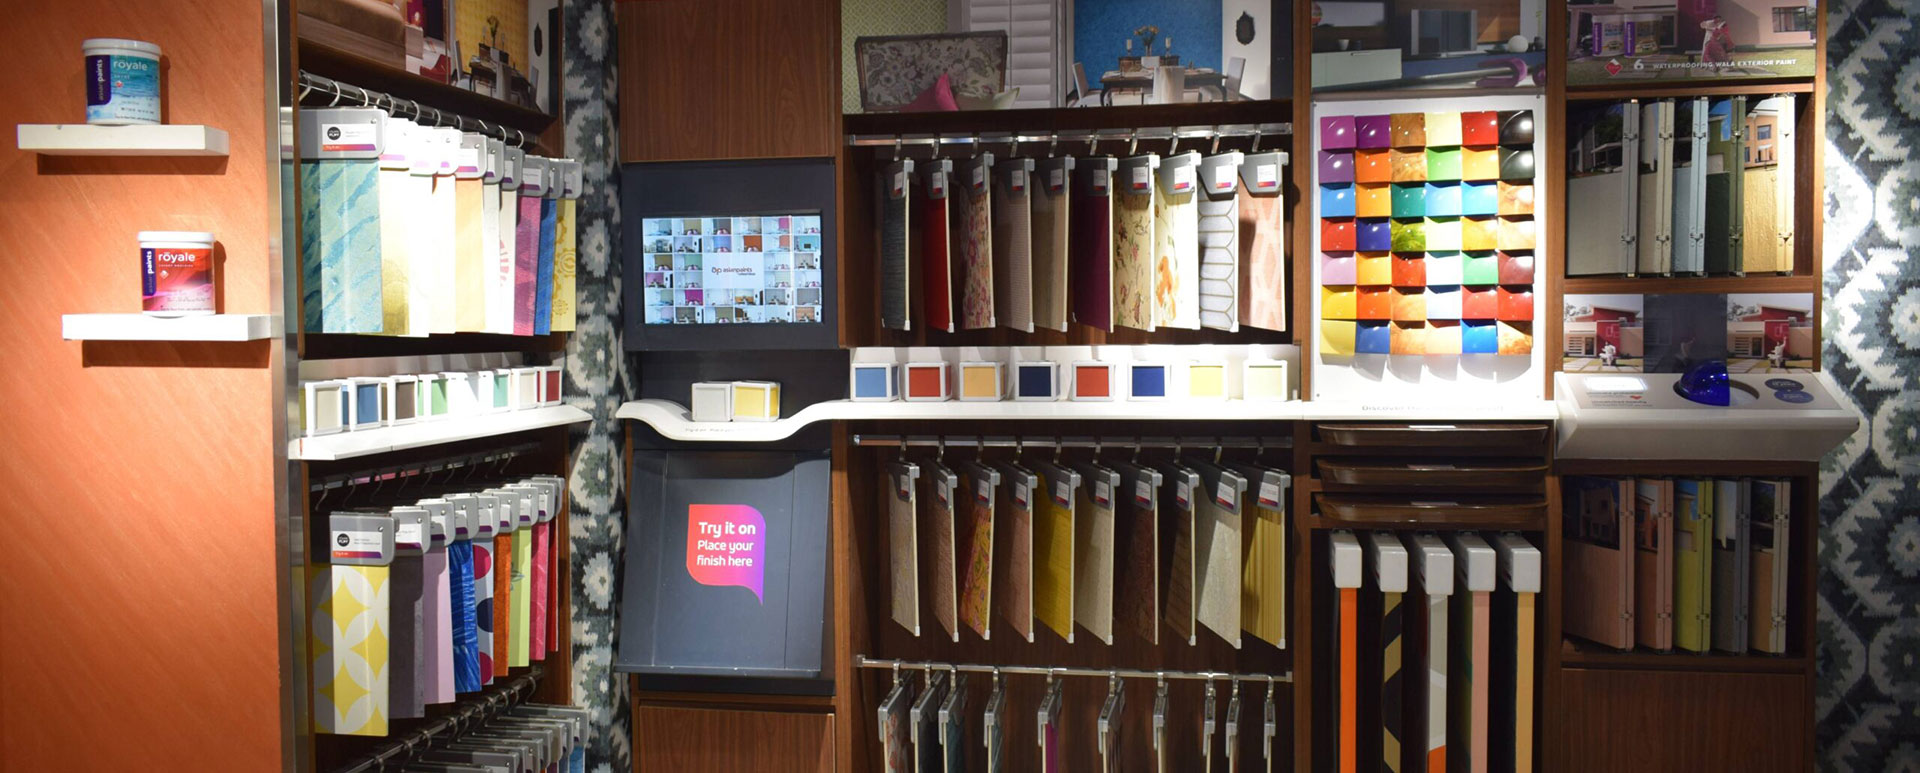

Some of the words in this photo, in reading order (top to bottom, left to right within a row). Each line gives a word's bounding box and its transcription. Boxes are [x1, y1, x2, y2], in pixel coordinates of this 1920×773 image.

[1634, 59, 1644, 71] 6
[1653, 61, 1713, 70] WATERPROOFING
[1738, 59, 1774, 67] EXTERIOR
[698, 521, 722, 538] Try
[725, 521, 736, 535] it
[738, 524, 756, 535] on
[697, 540, 727, 551] Place
[728, 542, 754, 554] your
[696, 555, 726, 566] finish
[728, 555, 753, 567] here
